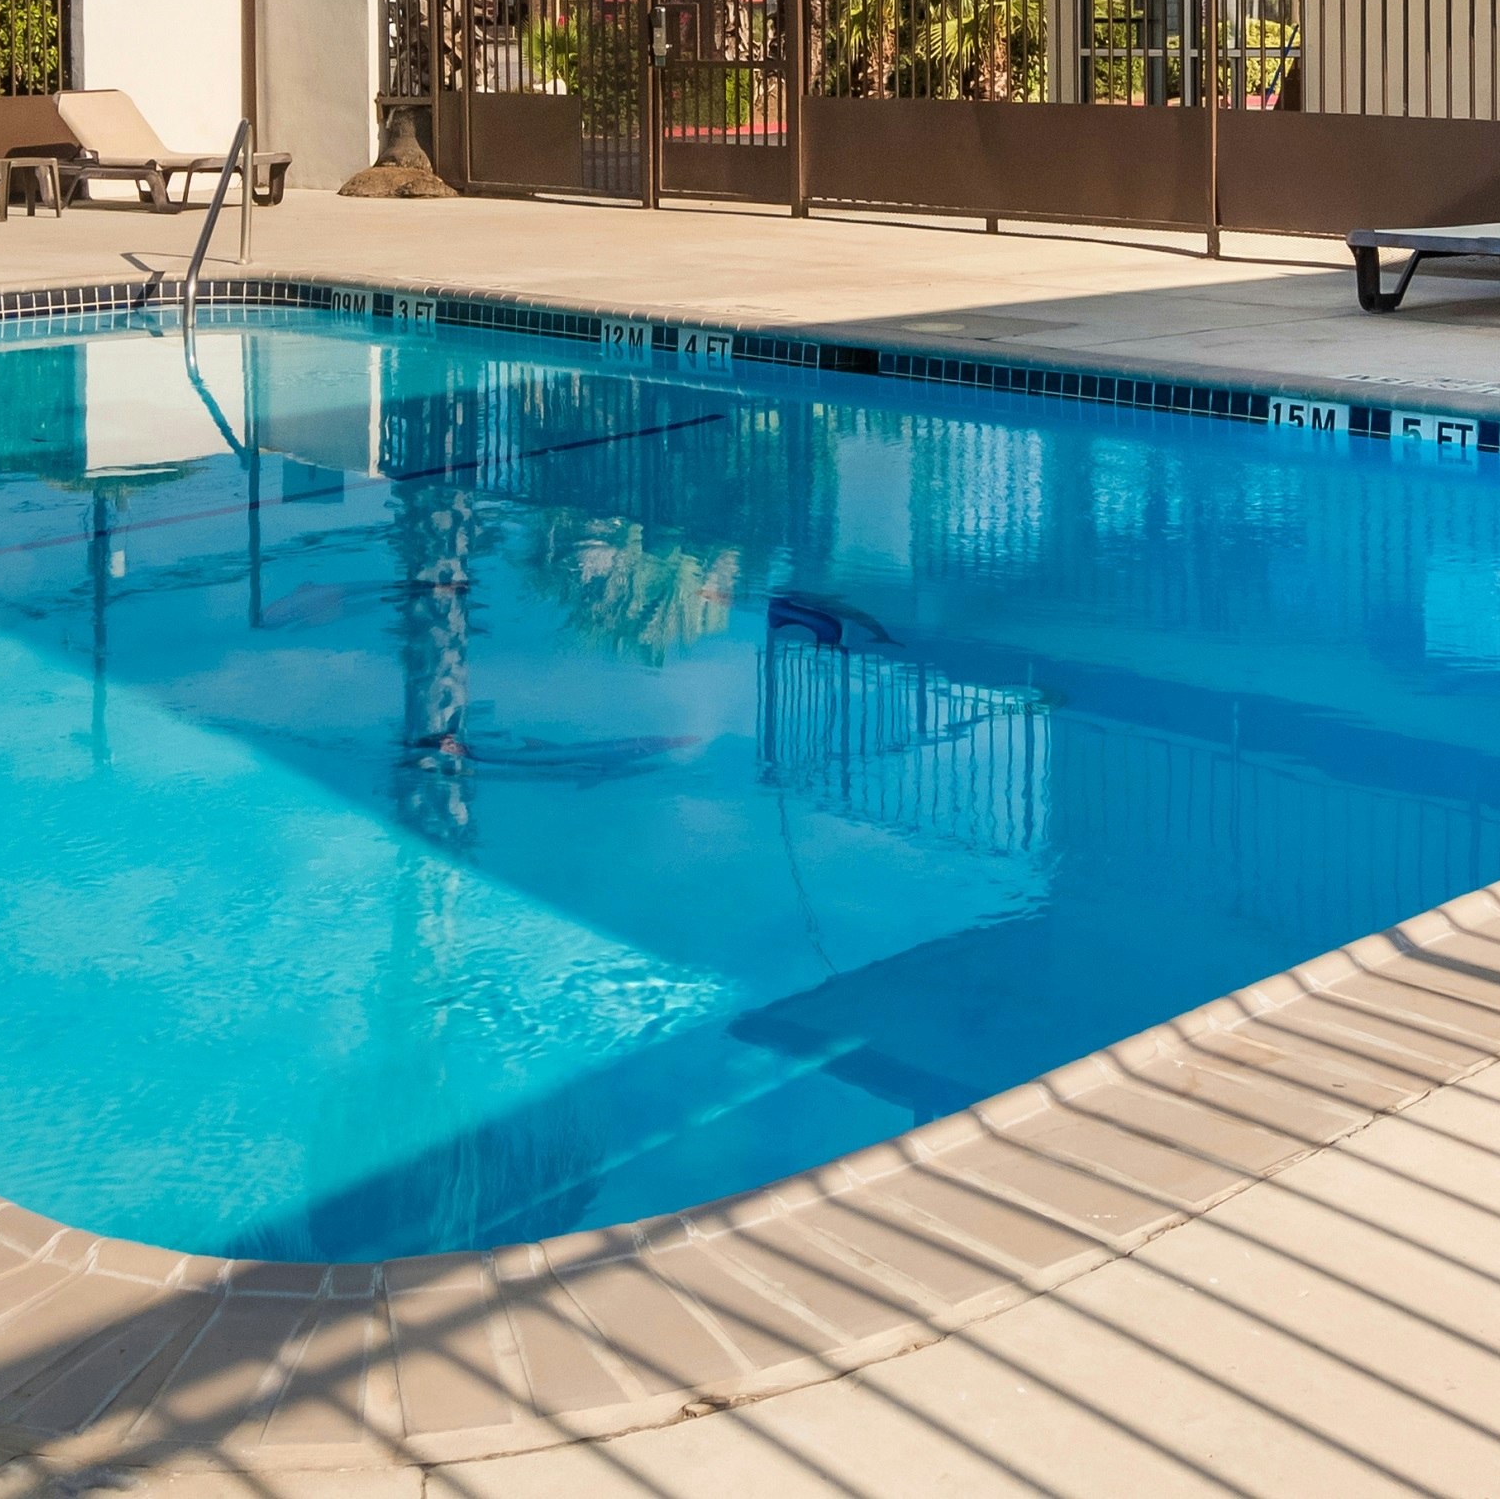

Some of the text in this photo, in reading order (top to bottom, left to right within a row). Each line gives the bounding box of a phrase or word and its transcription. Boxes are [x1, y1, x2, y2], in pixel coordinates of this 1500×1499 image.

[414, 301, 434, 320] FT
[684, 334, 698, 353] 4
[707, 336, 730, 357] FT
[1402, 417, 1423, 440] 5
[1438, 421, 1474, 447] FT
